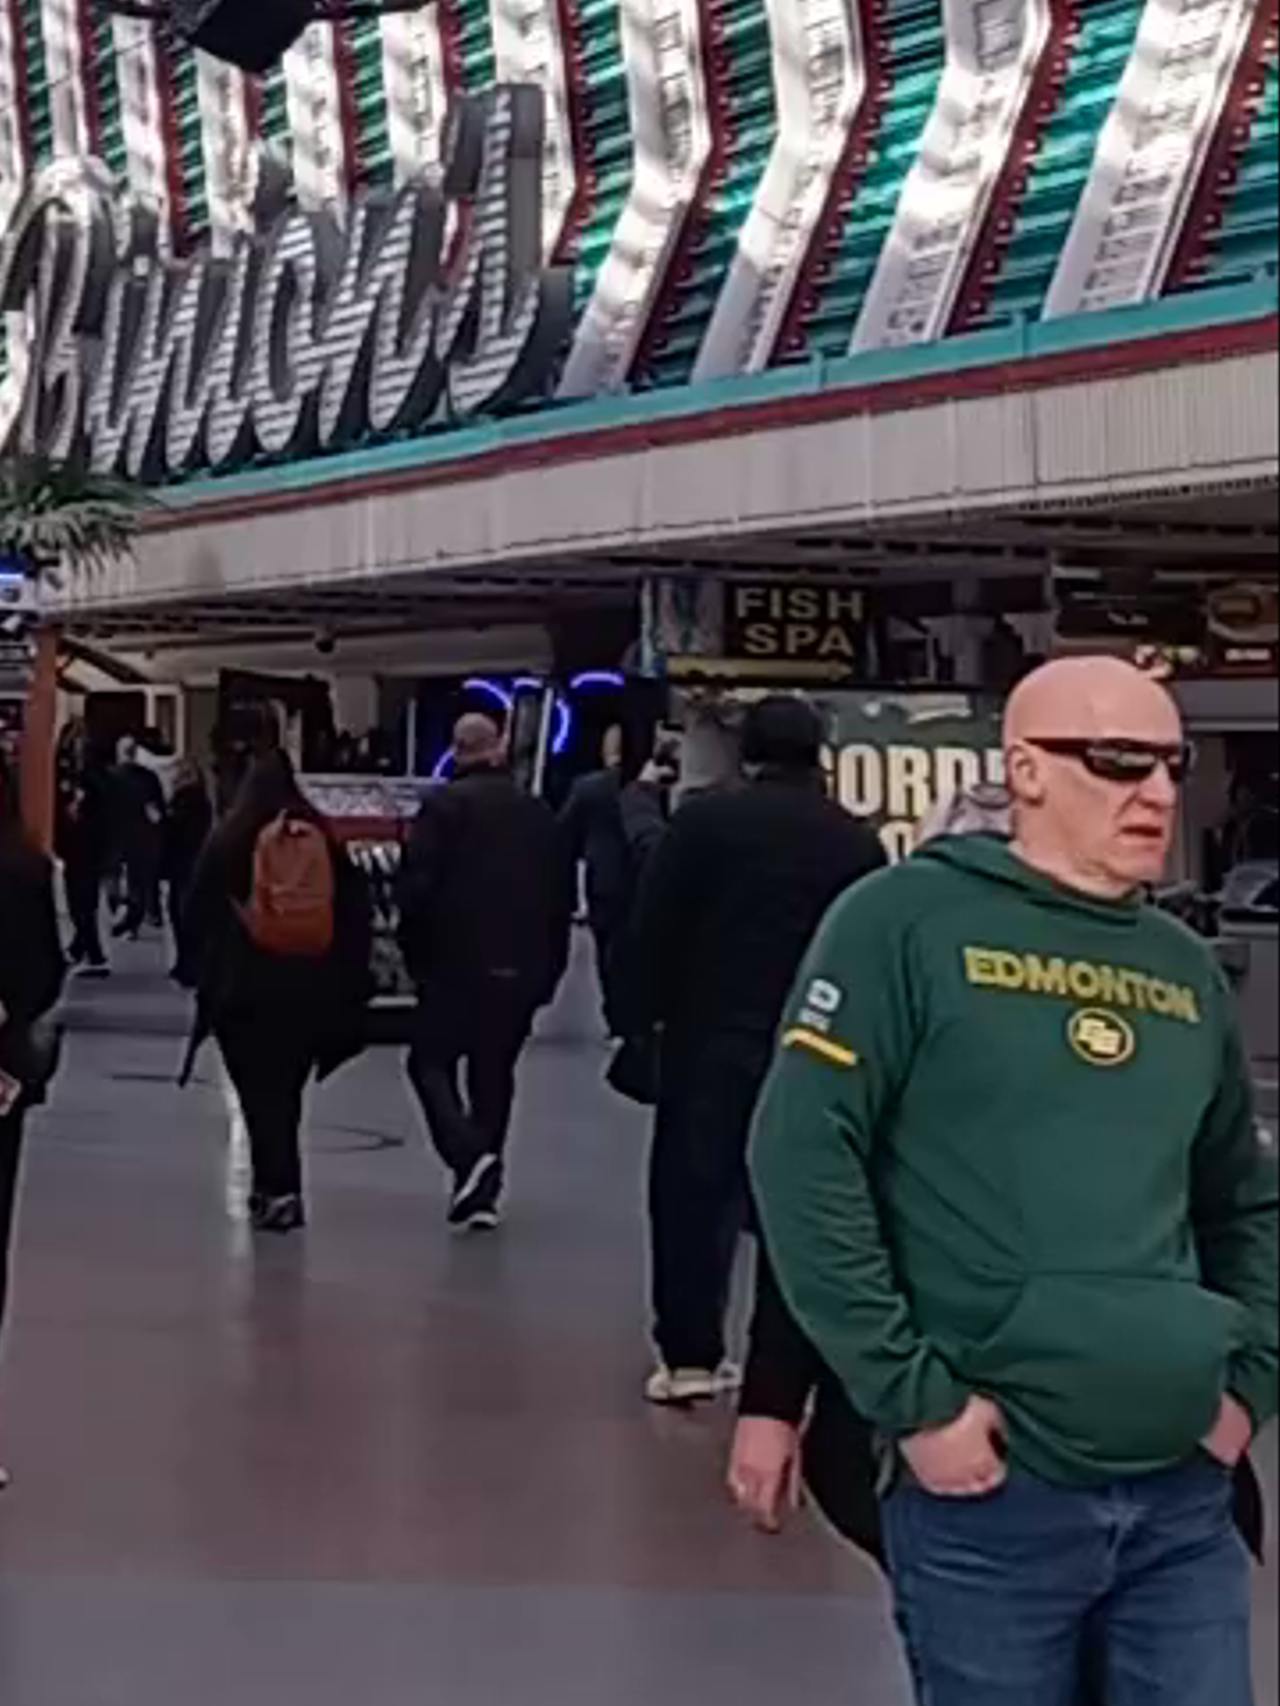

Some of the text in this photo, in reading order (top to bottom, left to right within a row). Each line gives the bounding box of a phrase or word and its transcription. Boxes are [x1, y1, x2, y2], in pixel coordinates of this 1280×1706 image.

[736, 588, 864, 620] FISH
[744, 624, 854, 656] SPA
[964, 946, 1199, 1024] EDMONTON
